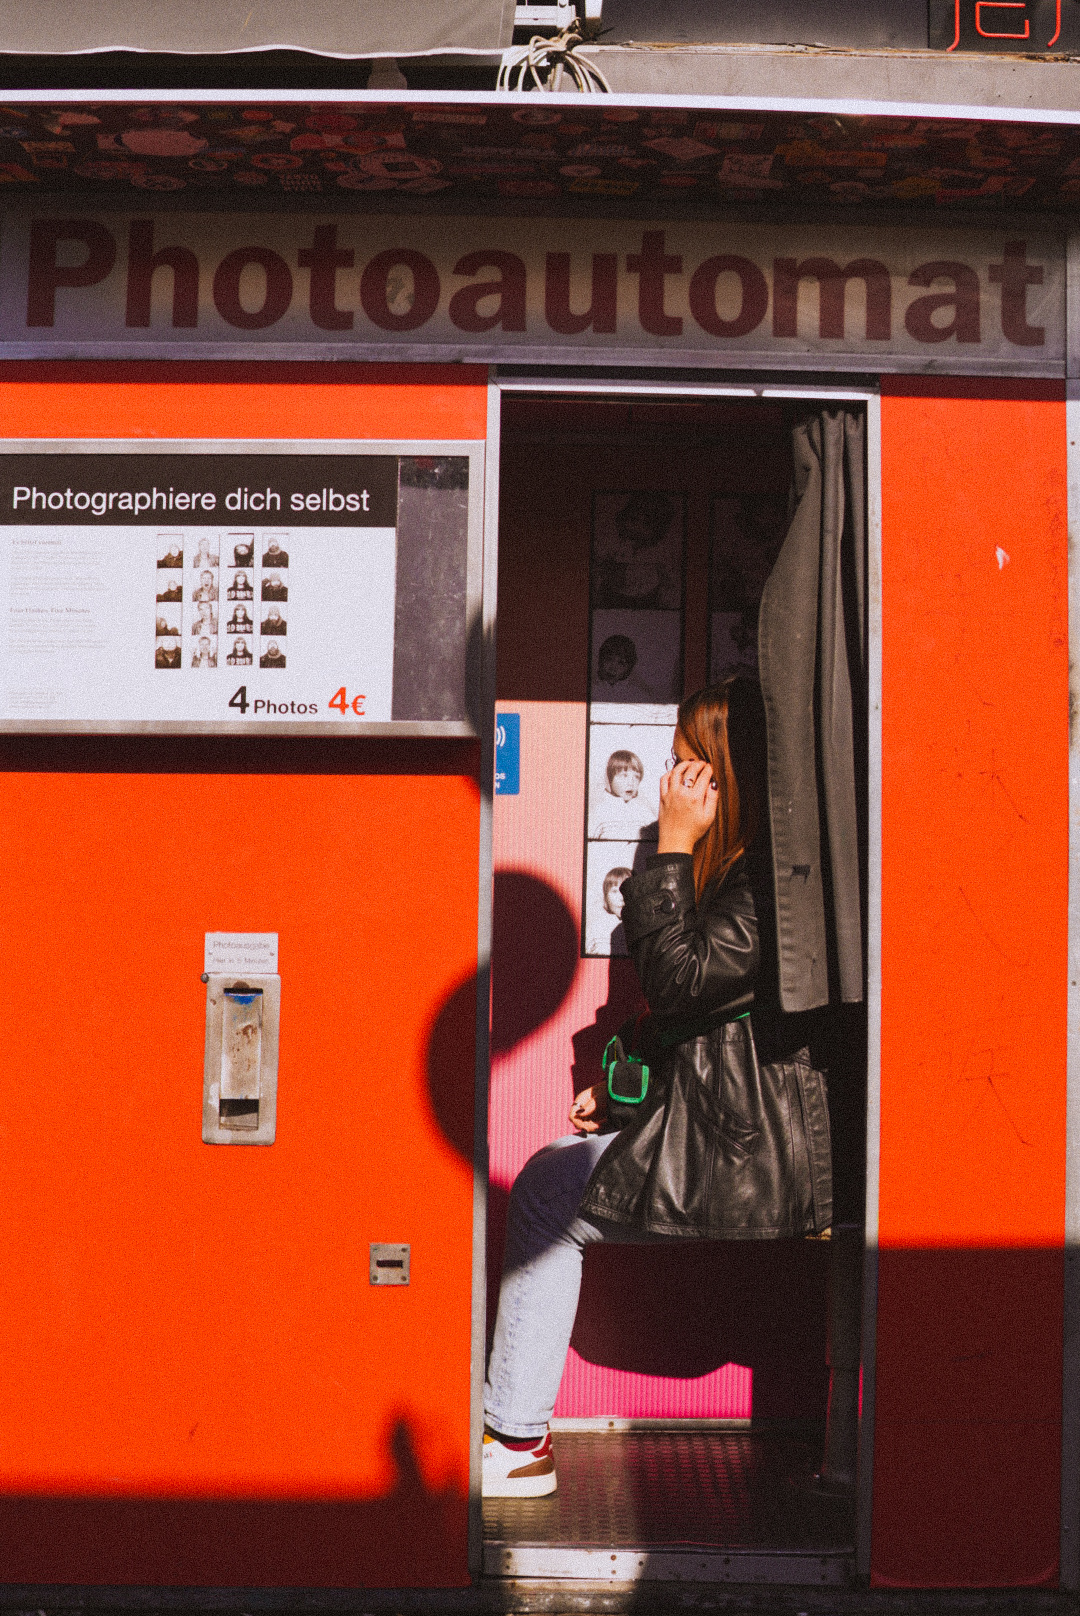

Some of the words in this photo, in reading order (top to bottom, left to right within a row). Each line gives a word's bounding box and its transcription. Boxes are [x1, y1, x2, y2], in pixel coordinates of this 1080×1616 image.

[26, 219, 1046, 347] Photoautomat
[12, 487, 217, 515] Photographiere
[225, 487, 281, 511] dich
[290, 488, 370, 512] selbst
[228, 685, 250, 714] 4
[254, 699, 318, 715] Photos
